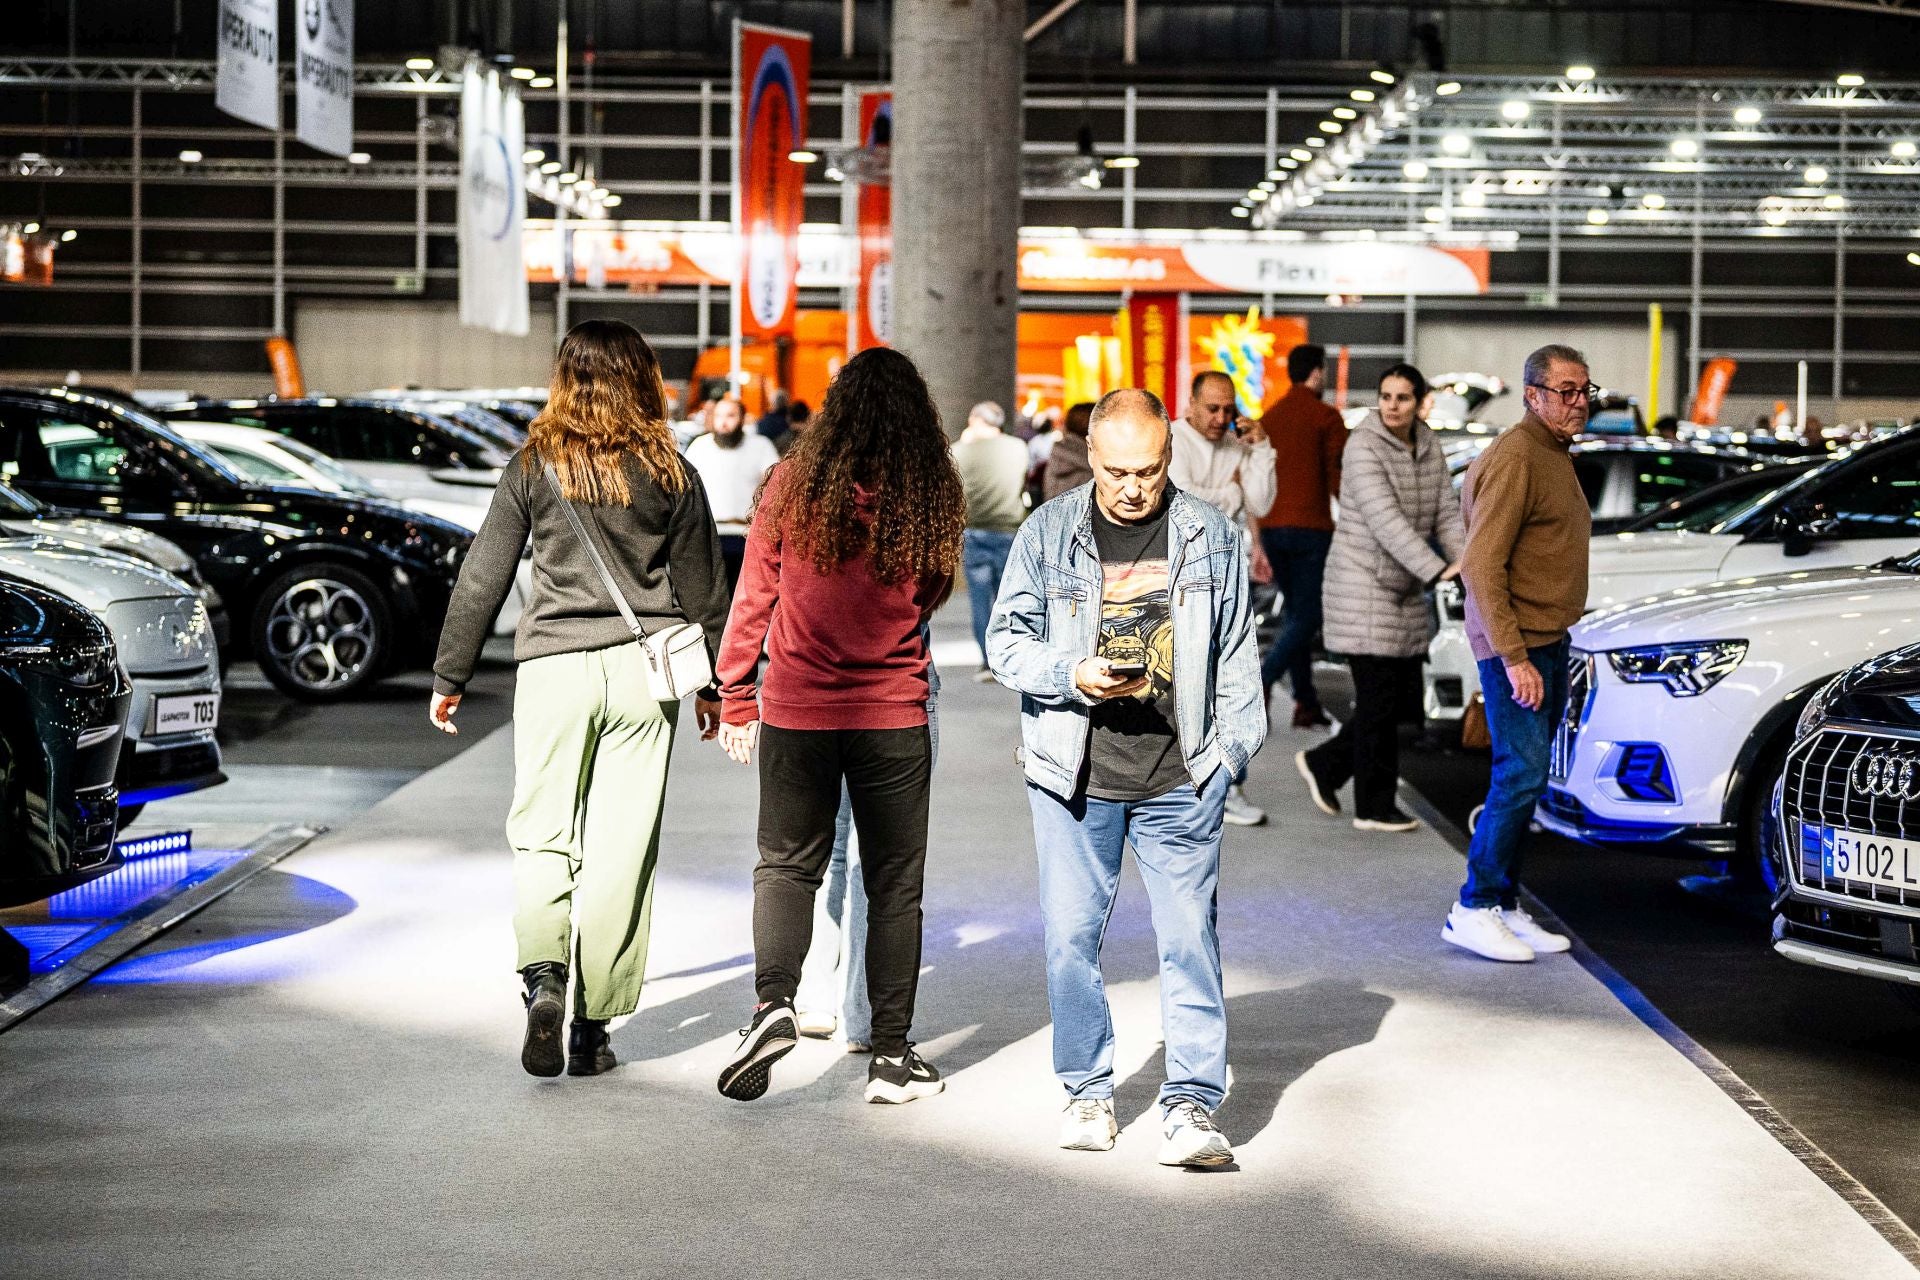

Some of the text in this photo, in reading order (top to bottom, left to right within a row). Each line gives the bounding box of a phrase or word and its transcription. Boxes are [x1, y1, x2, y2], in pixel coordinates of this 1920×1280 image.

[193, 700, 214, 723] T03
[1838, 838, 1894, 880] 5102
[1904, 847, 1917, 884] L
